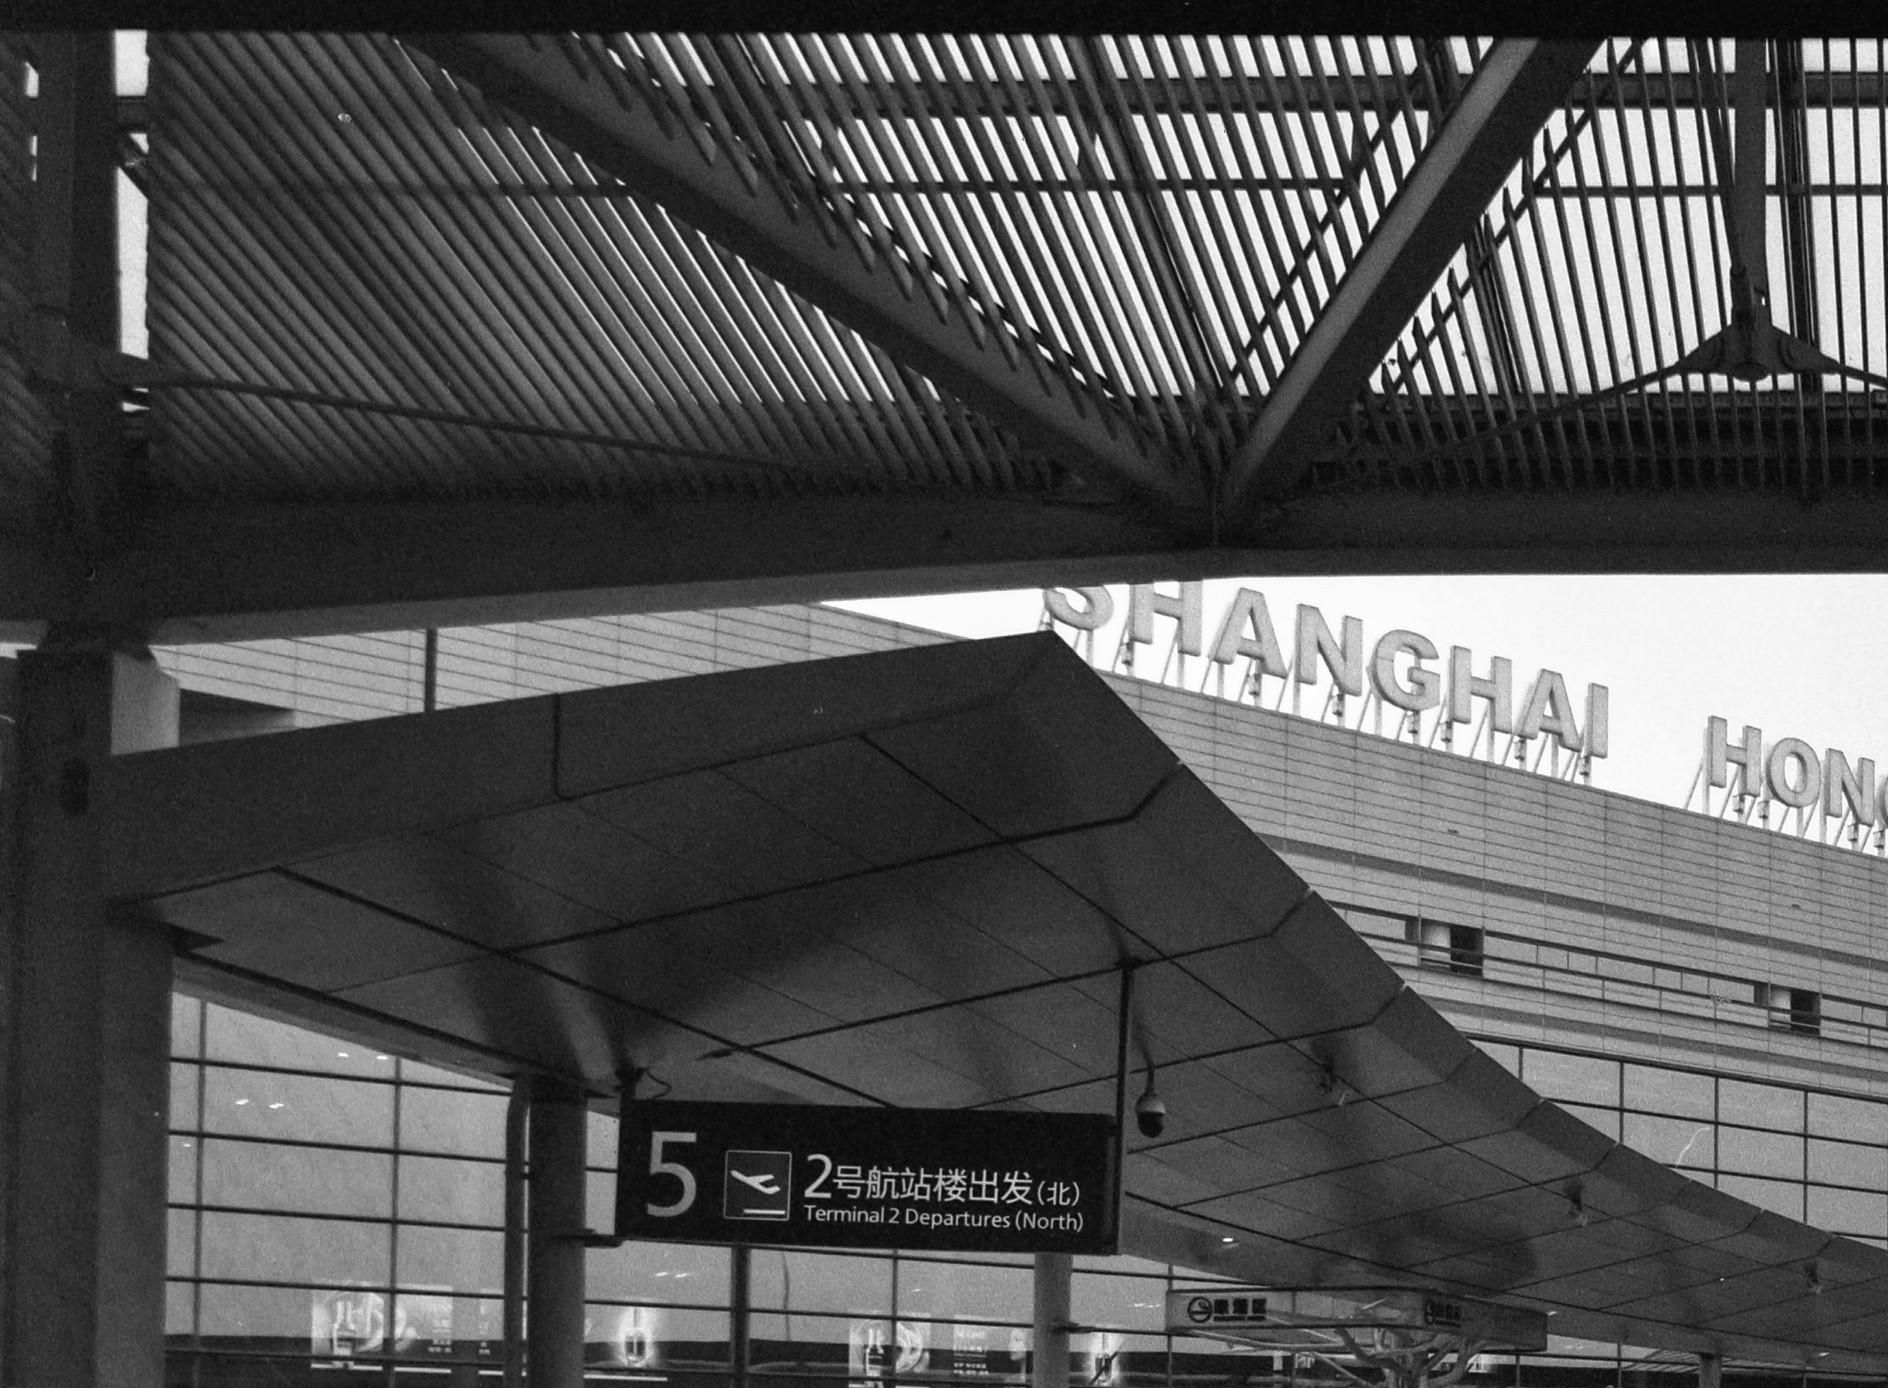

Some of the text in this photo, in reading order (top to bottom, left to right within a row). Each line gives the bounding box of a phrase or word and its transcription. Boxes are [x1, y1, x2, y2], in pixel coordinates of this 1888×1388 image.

[1043, 581, 1609, 759] SHANGHAI
[646, 1130, 698, 1218] 5
[804, 1204, 1084, 1233] Terminal 2 Departures (North)
